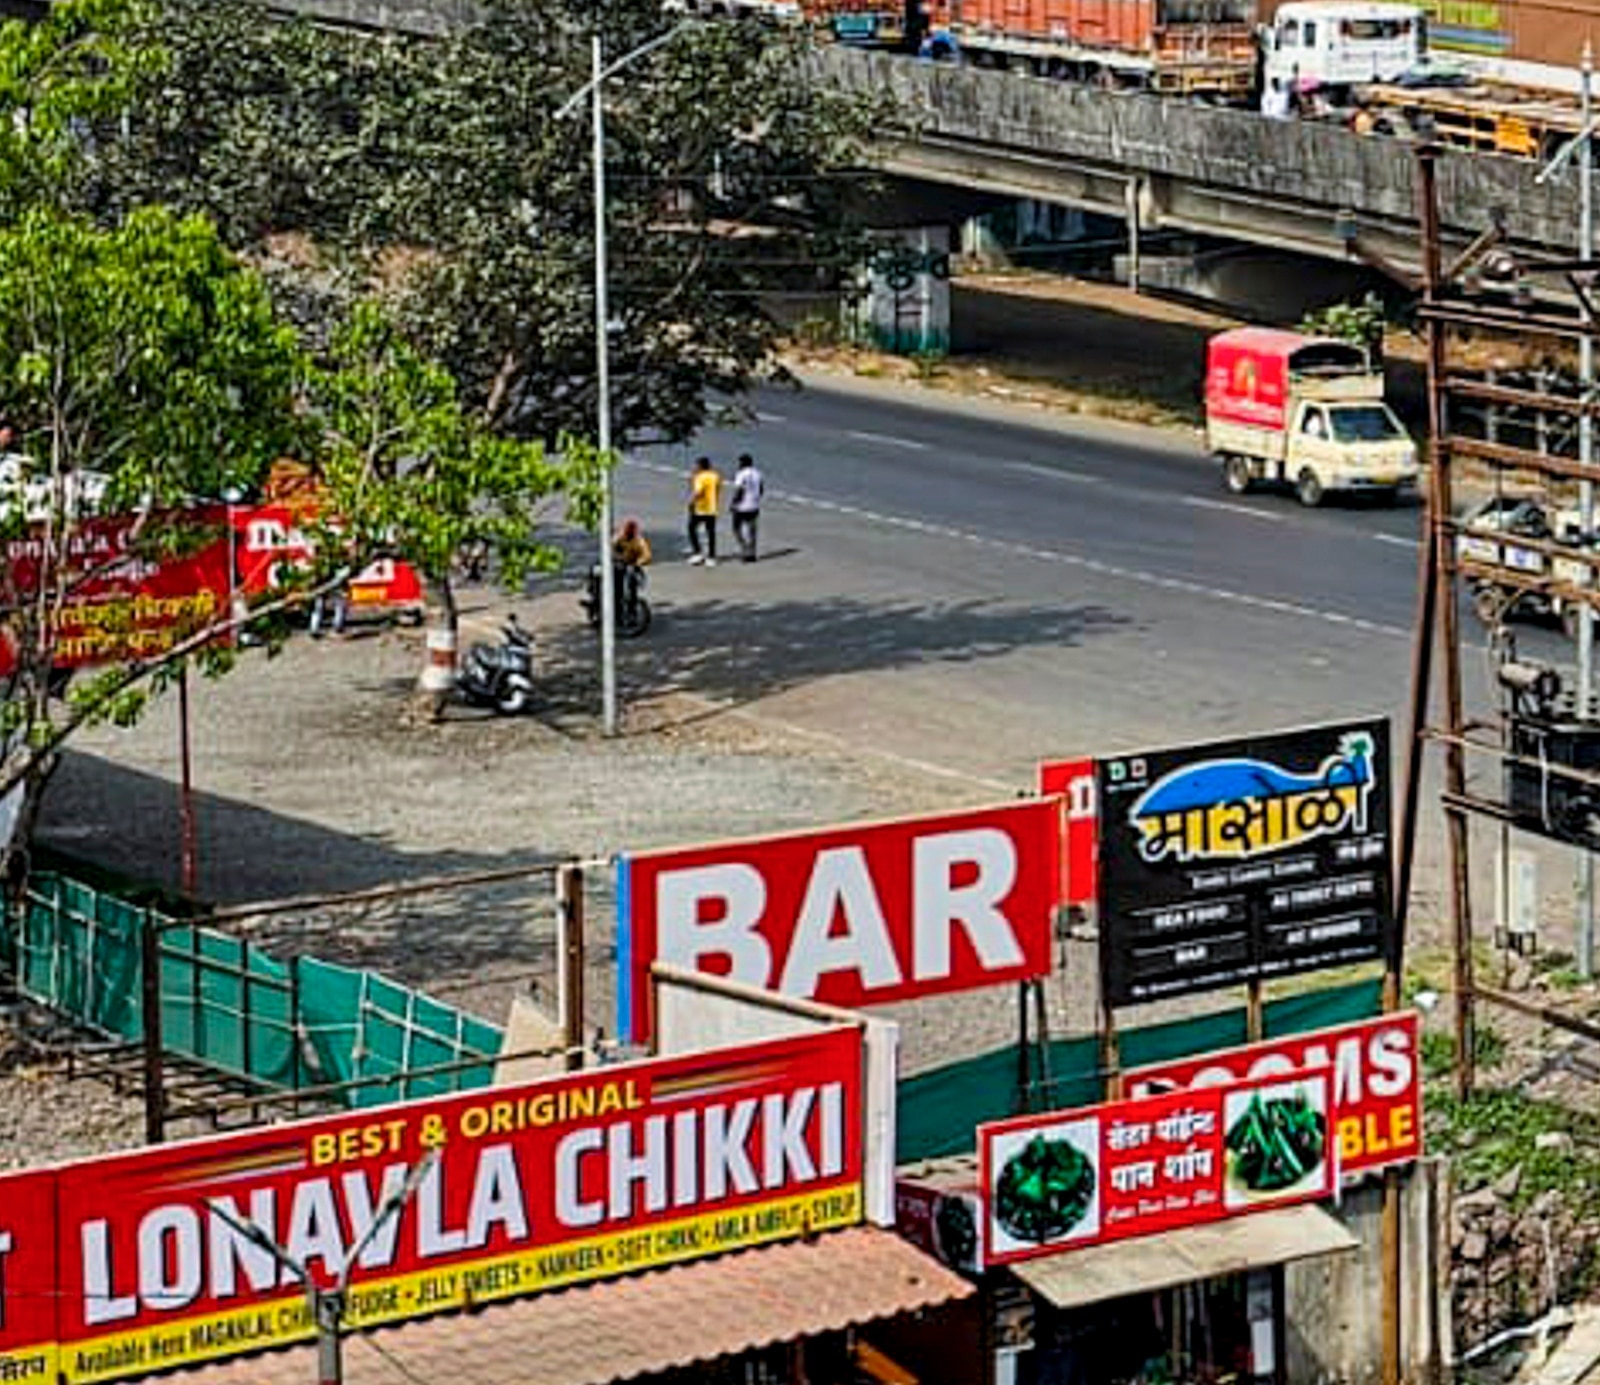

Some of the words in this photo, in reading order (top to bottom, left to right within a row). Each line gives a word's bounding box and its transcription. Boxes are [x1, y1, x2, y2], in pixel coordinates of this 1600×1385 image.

[656, 827, 1027, 999] BAR
[312, 1119, 406, 1166] BEST
[419, 1116, 447, 1147] &
[459, 1077, 645, 1139] ORIGINAL
[81, 1143, 528, 1325] LONAVLA
[555, 1081, 844, 1227] CHIKKI
[417, 1272, 458, 1303] JELLY
